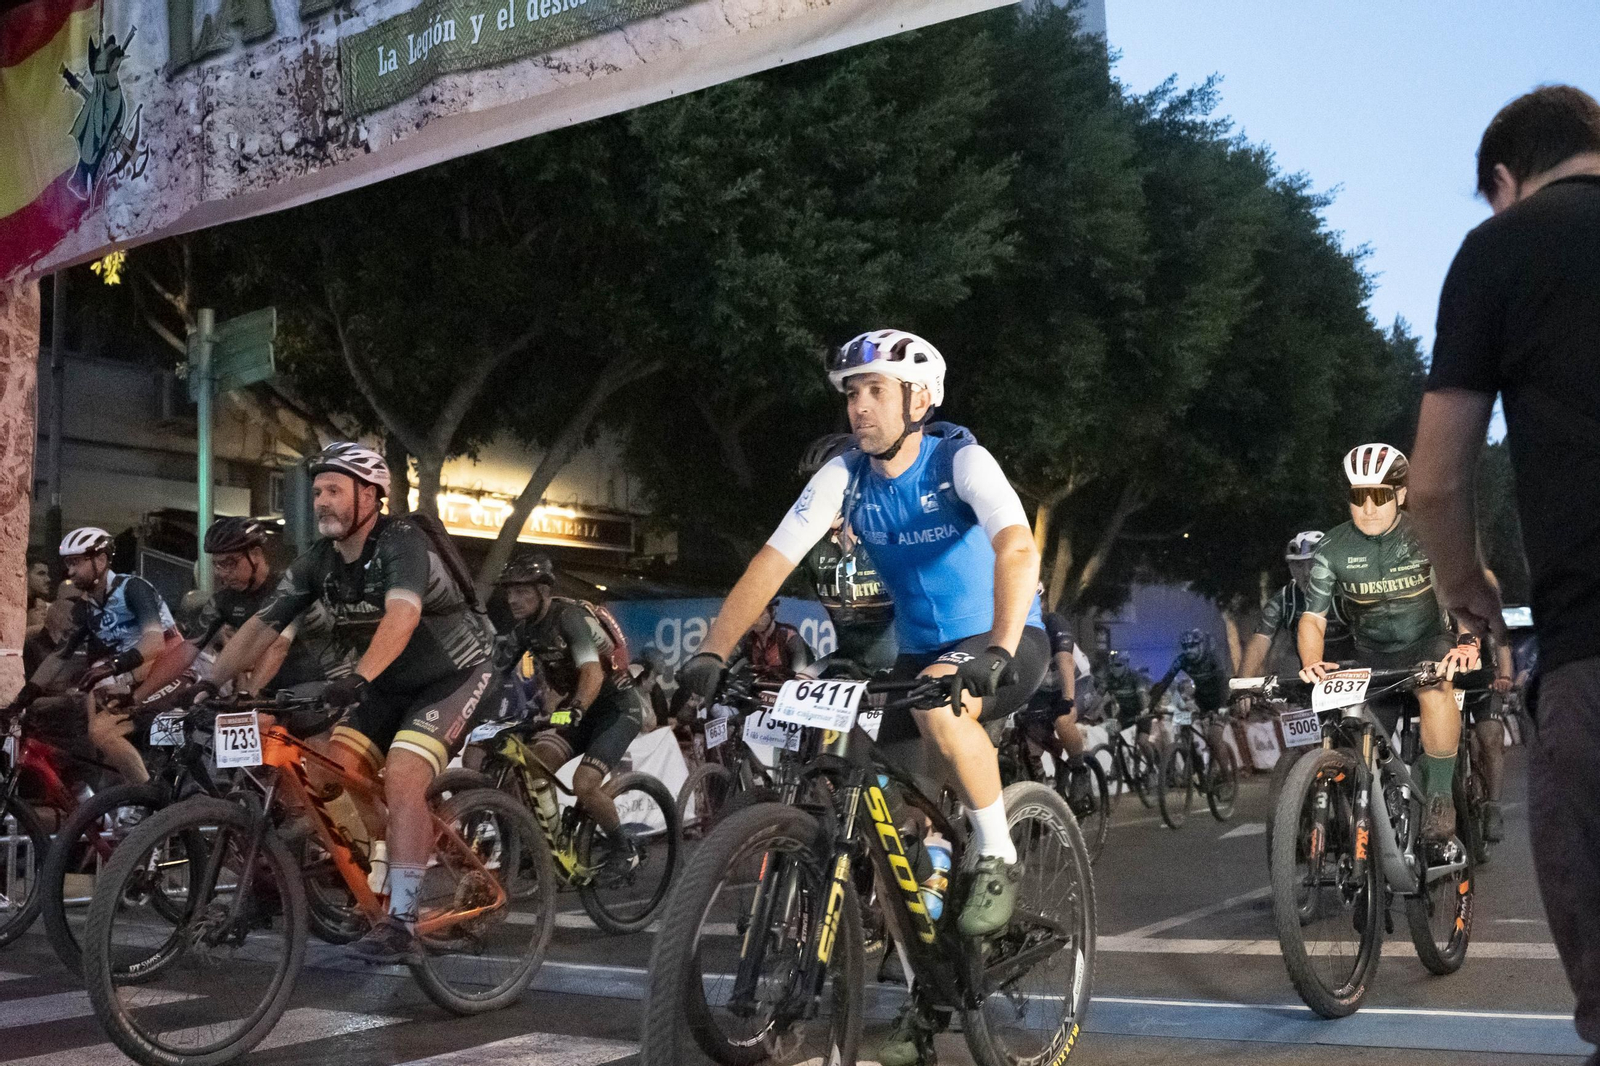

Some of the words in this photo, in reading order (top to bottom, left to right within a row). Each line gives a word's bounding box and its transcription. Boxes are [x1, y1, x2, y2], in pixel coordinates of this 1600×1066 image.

[378, 47, 398, 76] La
[407, 14, 456, 65] Legión
[469, 14, 484, 44] y
[497, 0, 515, 31] el
[526, 0, 588, 22] desi
[1342, 582, 1358, 594] LA
[1359, 573, 1426, 595] DESÉRTICA
[655, 616, 719, 667] ga
[795, 680, 857, 708] 6411
[1323, 680, 1367, 695] 6837
[709, 723, 727, 740] 6633
[1288, 718, 1318, 736] 5006
[222, 727, 258, 751] 7233
[863, 786, 937, 944] SCOTT
[129, 963, 141, 973] DT
